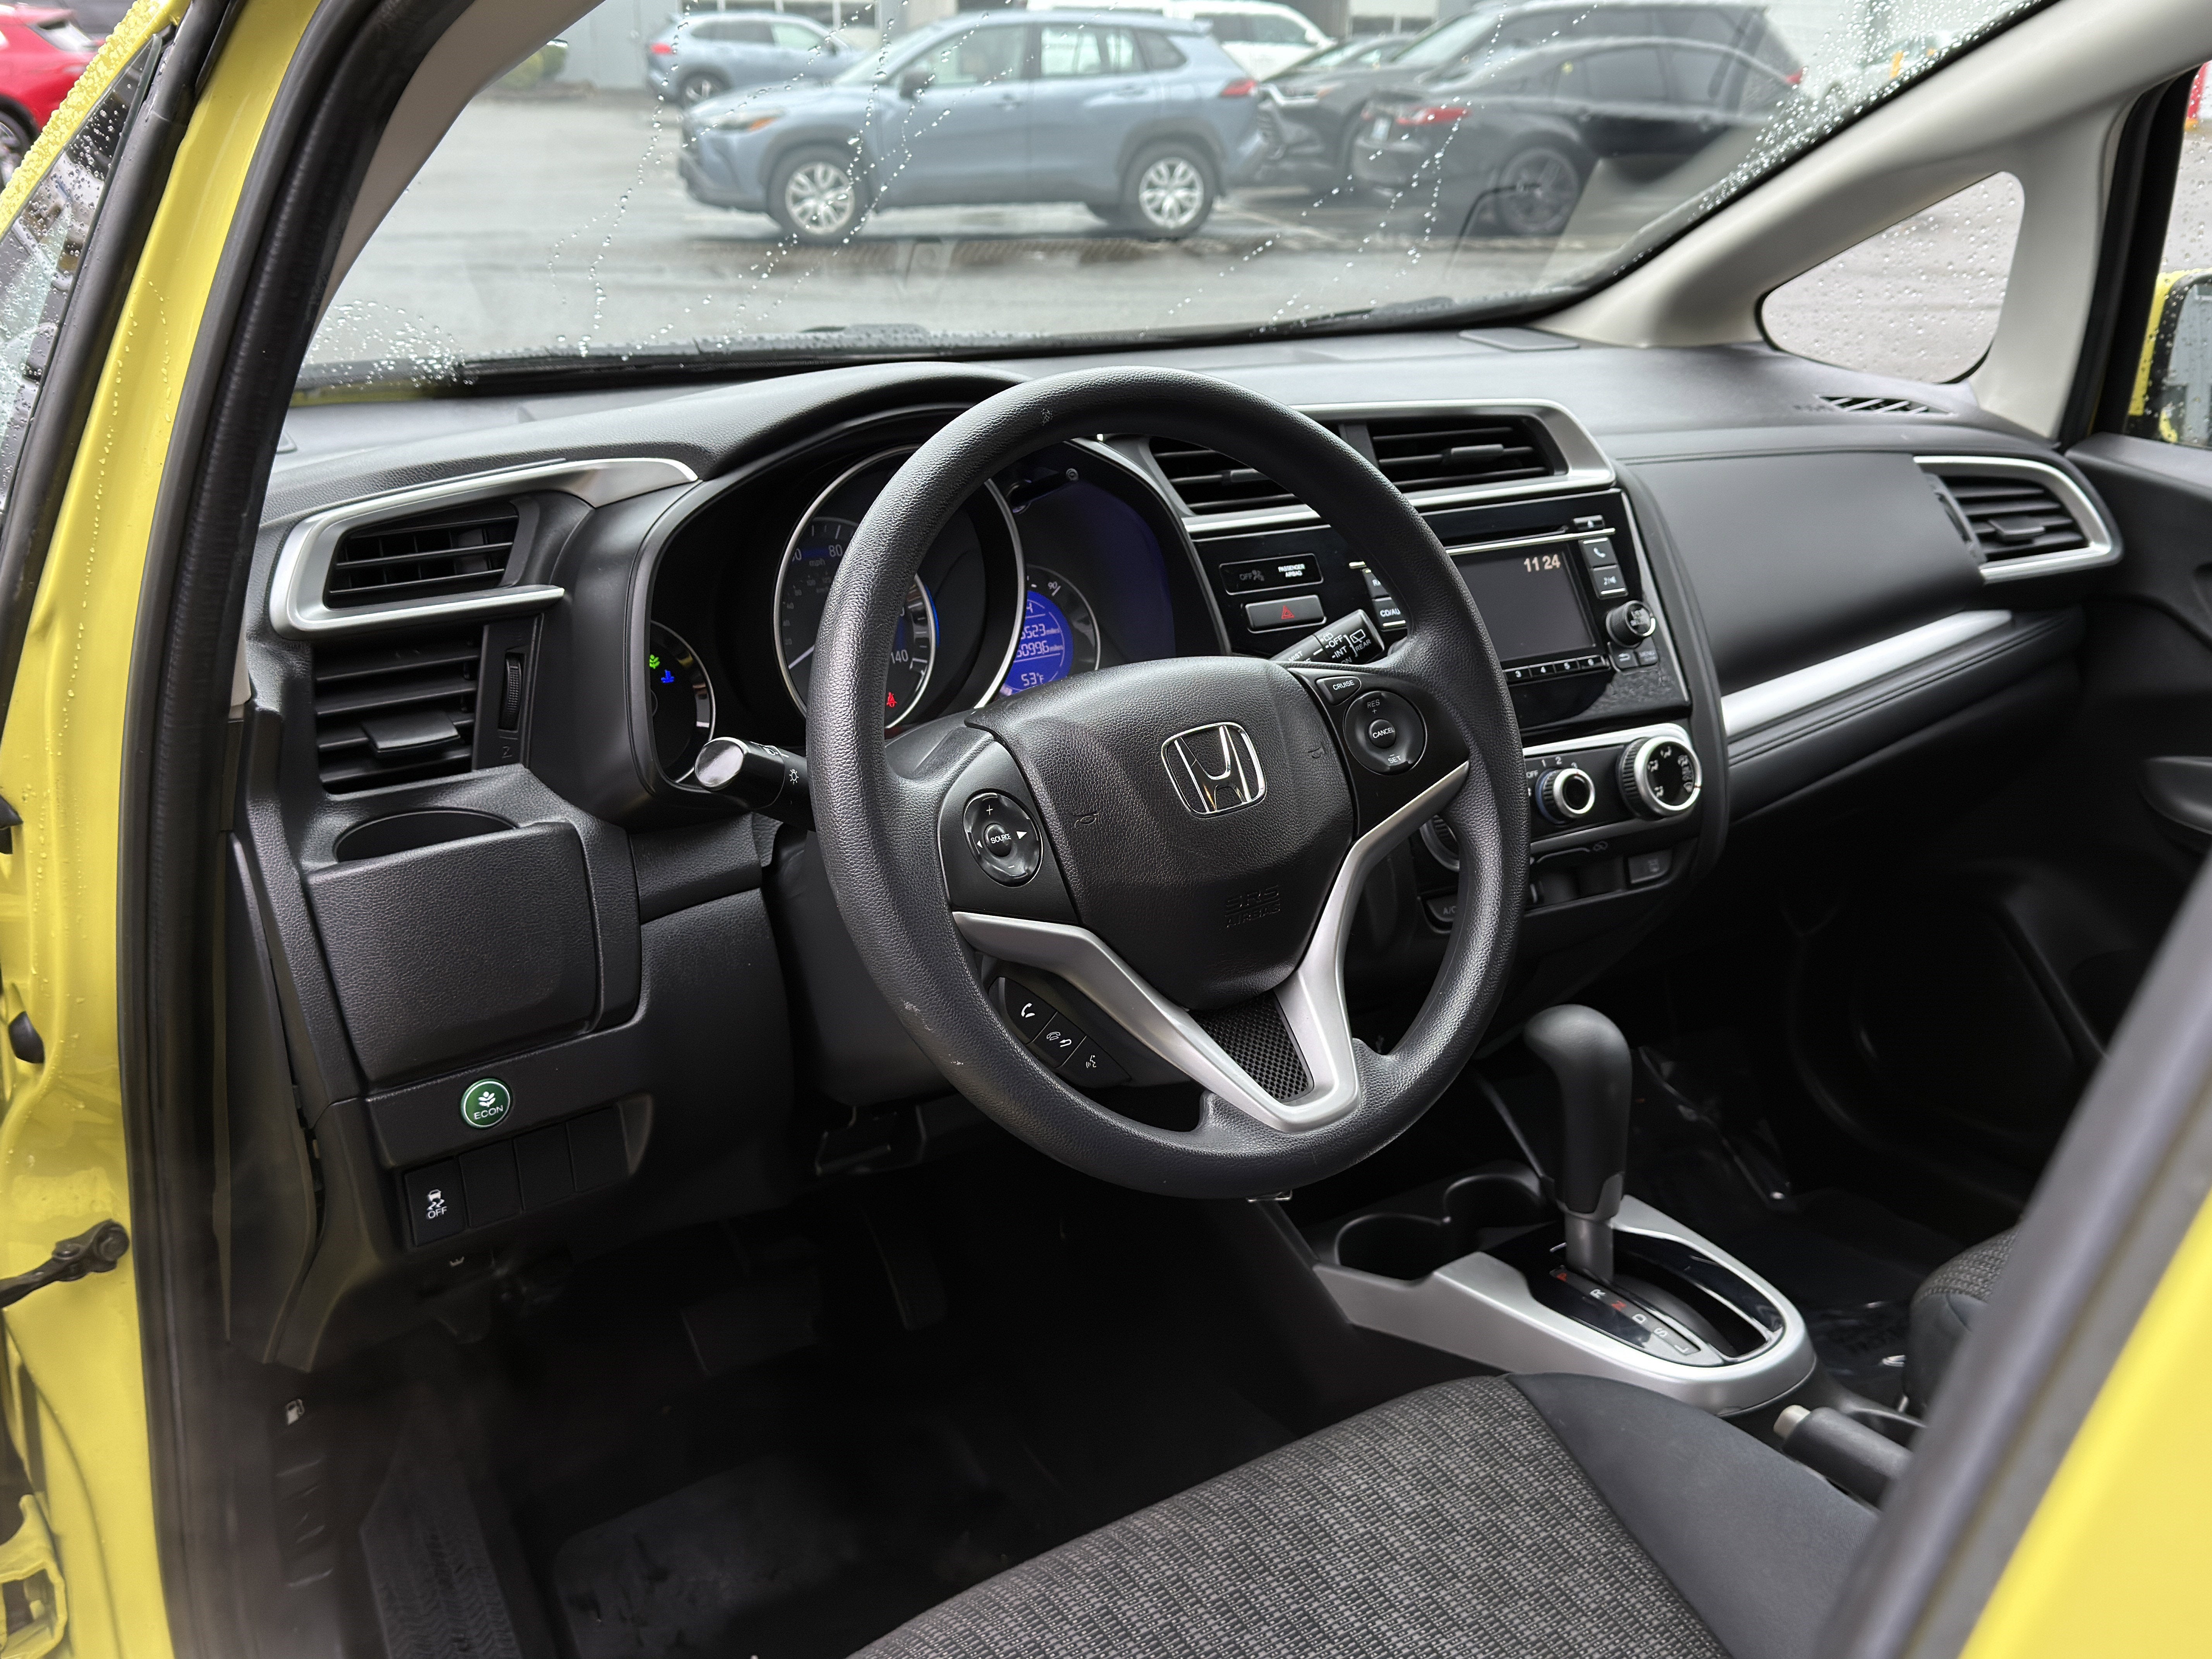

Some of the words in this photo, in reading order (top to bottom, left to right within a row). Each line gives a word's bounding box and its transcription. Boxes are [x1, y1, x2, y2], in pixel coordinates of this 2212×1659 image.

[828, 544, 843, 558] 80
[1523, 558, 1540, 572] 11
[1542, 554, 1561, 570] 24
[1328, 634, 1343, 648] OFF
[1355, 639, 1371, 651] REAR
[890, 649, 909, 665] 140
[1288, 650, 1303, 662] MIST
[1334, 645, 1347, 658] INT
[1333, 680, 1355, 690] CRUISE
[1367, 699, 1380, 708] RES
[1372, 727, 1395, 738] CANCEL
[1388, 755, 1402, 764] SET
[1555, 756, 1562, 765] 2
[990, 833, 1012, 844] SOURCE
[1226, 884, 1280, 913] SRS
[474, 1104, 503, 1120] ECON
[428, 1206, 447, 1219] OFF
[1590, 1289, 1606, 1299] R
[1611, 1300, 1626, 1312] N
[1632, 1313, 1647, 1325] D
[1654, 1327, 1668, 1338] S
[1674, 1344, 1689, 1354] L
